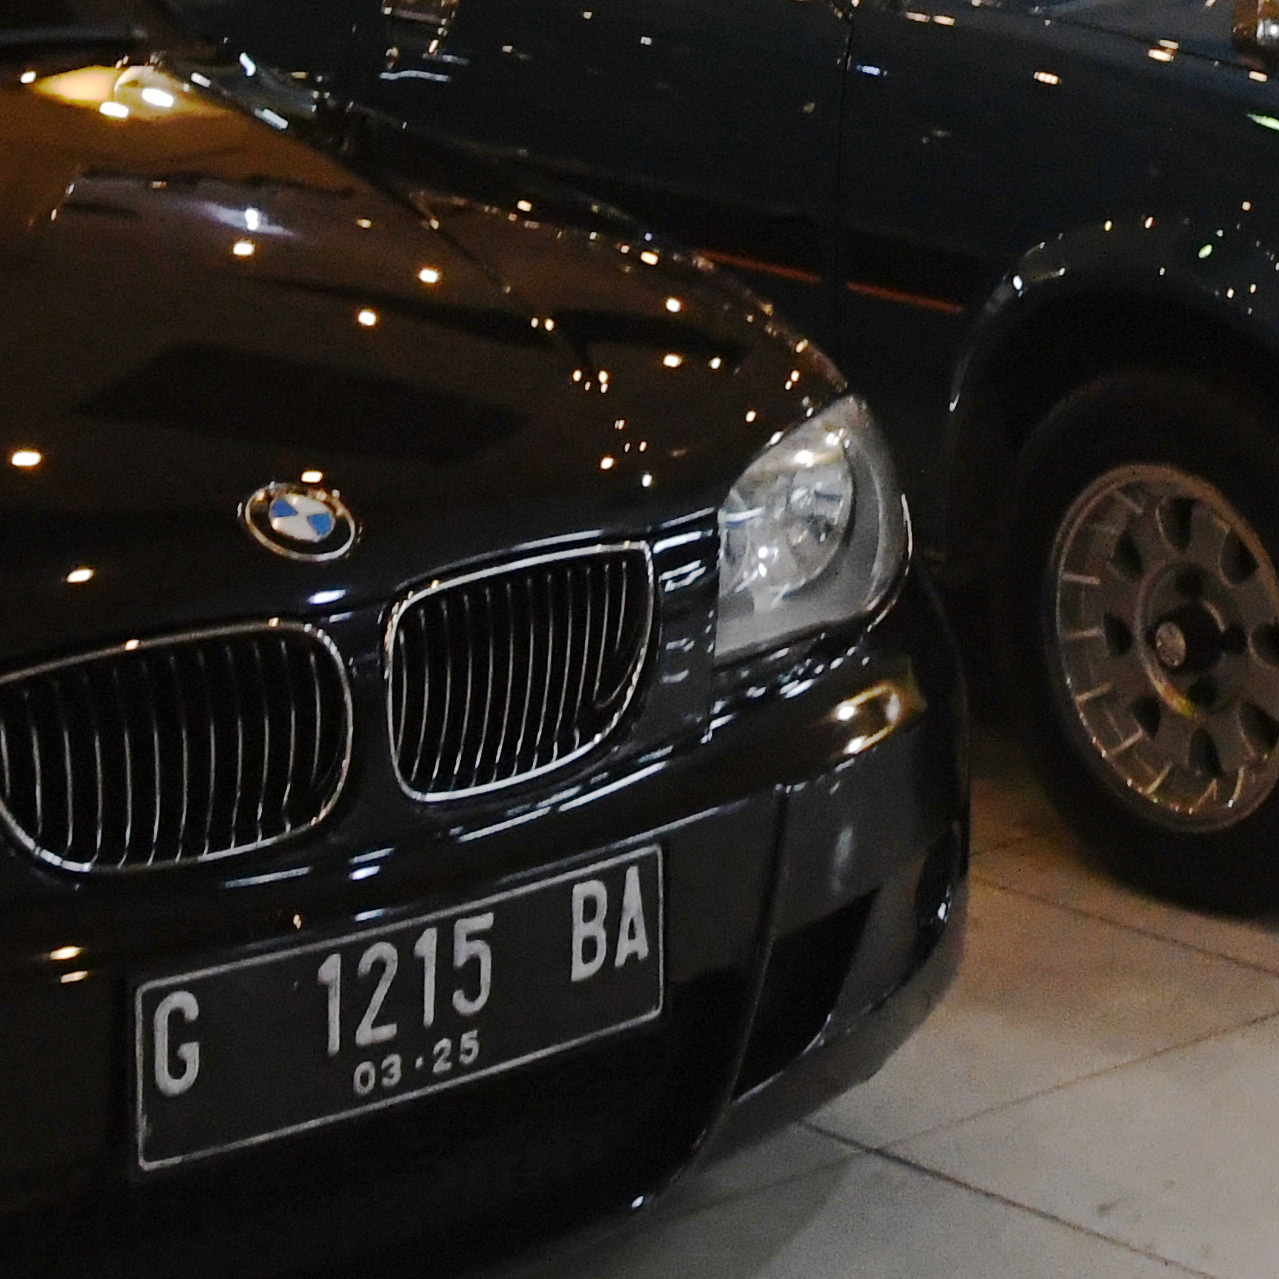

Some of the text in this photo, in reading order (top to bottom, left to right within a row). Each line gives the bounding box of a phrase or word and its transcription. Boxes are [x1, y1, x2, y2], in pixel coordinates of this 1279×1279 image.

[153, 865, 649, 1096] G 1215 BA
